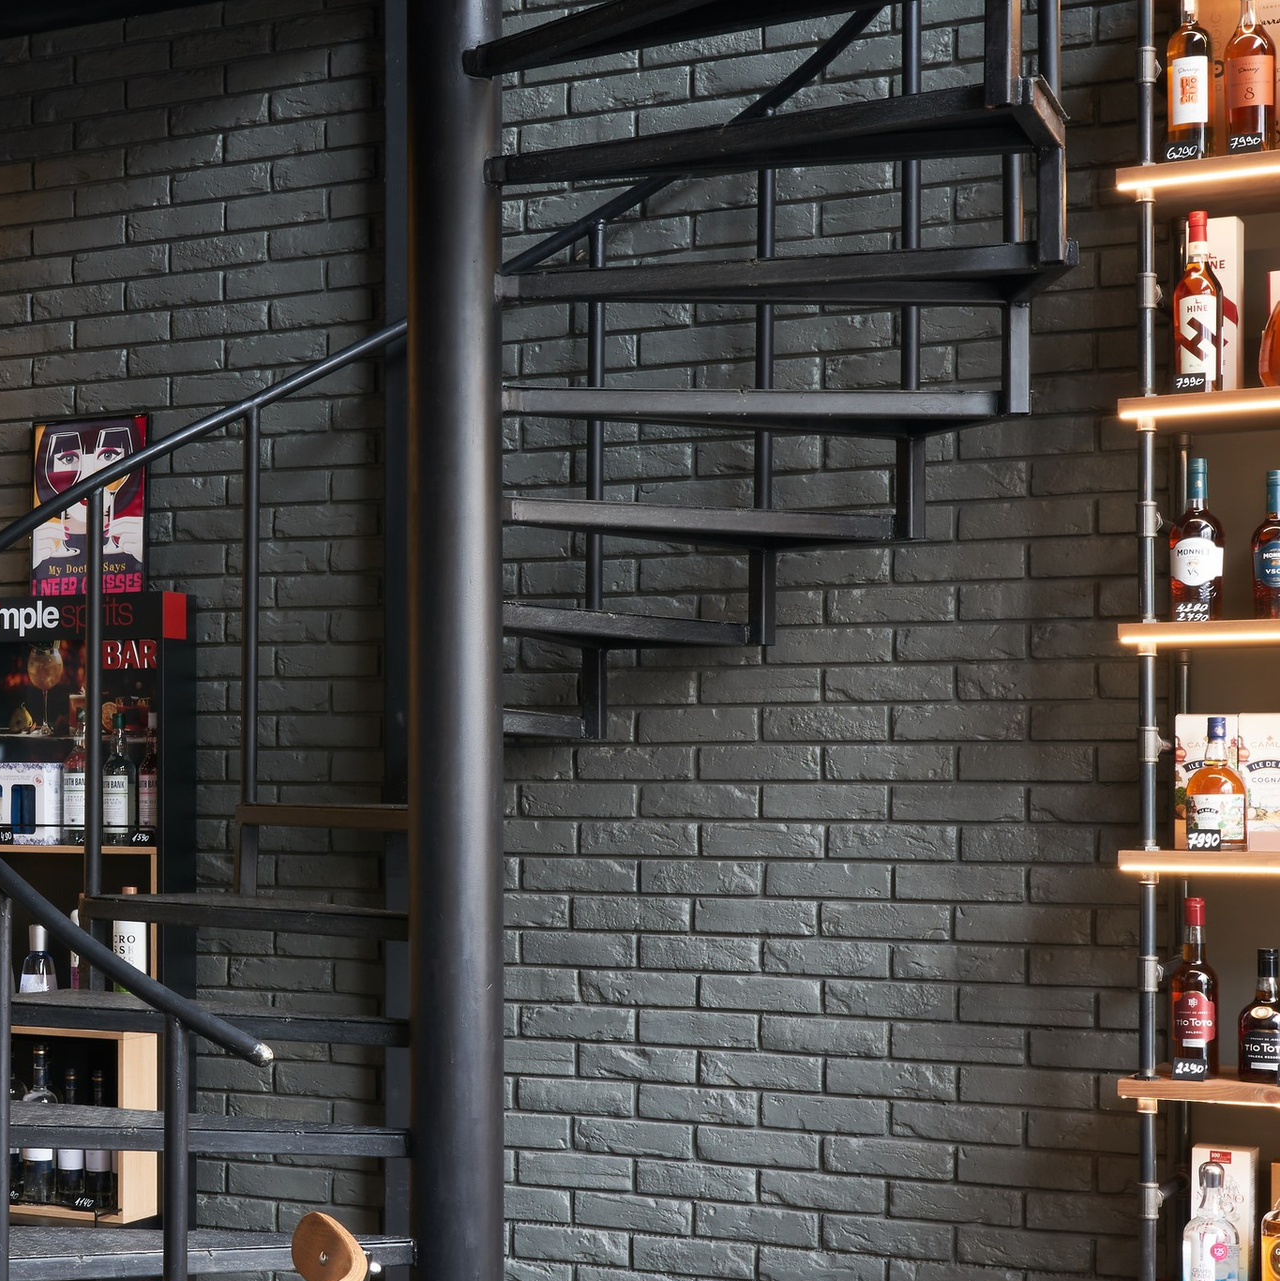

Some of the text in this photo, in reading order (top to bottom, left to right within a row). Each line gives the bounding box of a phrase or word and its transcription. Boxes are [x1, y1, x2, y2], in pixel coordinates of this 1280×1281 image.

[1230, 136, 1261, 149] 7990
[1166, 145, 1198, 160] 6290
[1186, 305, 1208, 313] HINE
[1175, 377, 1205, 389] 7990
[48, 561, 126, 576] My Doct Says
[32, 579, 37, 596] I
[40, 576, 78, 597] NEED
[61, 596, 134, 635] spits
[102, 639, 158, 669] BAR
[110, 780, 125, 789] BANK
[1188, 832, 1220, 849] 7990
[1175, 1061, 1205, 1074] 2290
